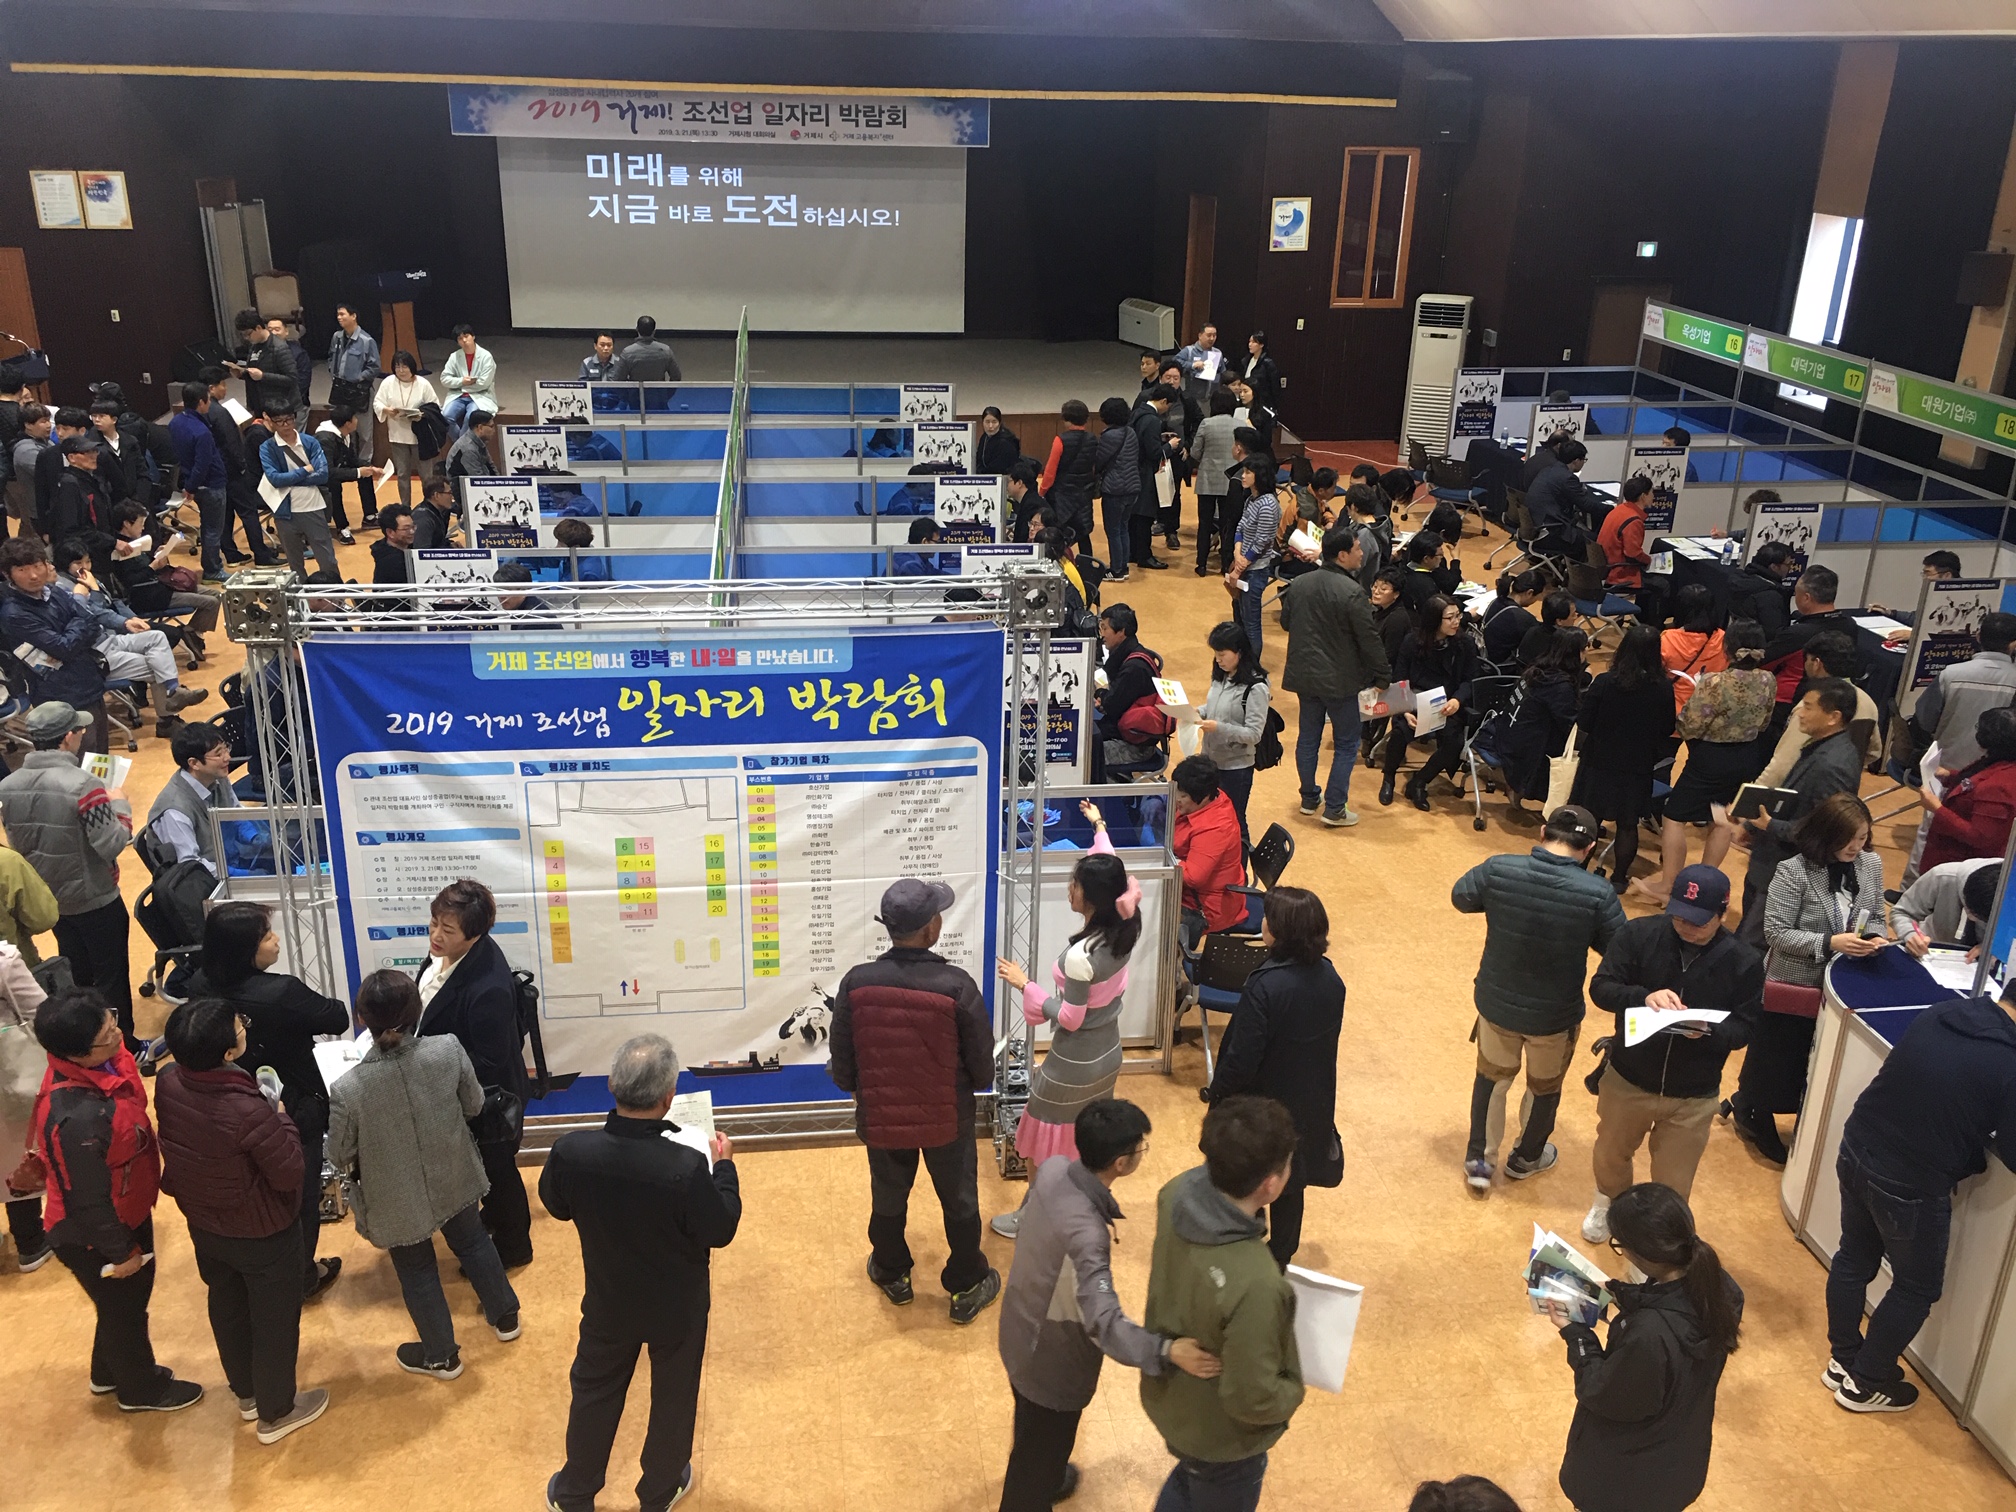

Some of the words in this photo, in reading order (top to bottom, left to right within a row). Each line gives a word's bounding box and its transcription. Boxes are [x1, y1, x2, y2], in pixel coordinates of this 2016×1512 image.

[528, 99, 600, 123] 2019
[607, 99, 673, 135] 거제!
[682, 100, 753, 125] 조선업
[761, 101, 830, 127] 일자리
[839, 103, 907, 129] 박람회
[586, 152, 690, 187] 미래를
[698, 166, 743, 187] 위해
[588, 193, 660, 224] 지금
[668, 204, 714, 224] 바로
[722, 194, 901, 227] 도전하십시오!
[1682, 322, 1711, 345] 옥성기업
[1728, 337, 1739, 351] 16
[1790, 356, 1827, 380] 대덕기업
[1848, 373, 1860, 387] 17
[2002, 420, 2014, 434] 18
[488, 651, 529, 673] 거제
[533, 650, 625, 671] 조선업에서
[629, 648, 686, 669] 행복한
[691, 647, 752, 668] 내:일을
[755, 647, 839, 667] 만났습니다.
[386, 711, 454, 735] 2019
[464, 712, 524, 739] 거제
[531, 706, 611, 739] 조선업
[617, 679, 765, 743] 일자리
[788, 673, 948, 735] 박람회
[770, 755, 808, 766] 참가기업
[811, 755, 831, 765] 목차
[378, 763, 420, 775] 행사목적
[548, 762, 578, 772] 행사장
[581, 761, 611, 771] 배치도
[386, 832, 426, 842] 행사개요
[621, 843, 628, 851] 6
[639, 842, 650, 850] 15
[709, 839, 720, 848] 16
[551, 845, 557, 853] 5
[623, 860, 629, 868] 7
[640, 859, 651, 867] 14
[710, 857, 720, 865] 17
[552, 862, 559, 870] 4
[624, 877, 630, 885] 8
[641, 876, 651, 884] 13
[711, 873, 721, 881] 18
[553, 879, 560, 888] 3
[641, 891, 652, 899] 12
[711, 889, 721, 897] 19
[1683, 881, 1700, 900] B
[554, 895, 561, 903] 2
[624, 892, 631, 900] 9
[712, 905, 723, 913] 20
